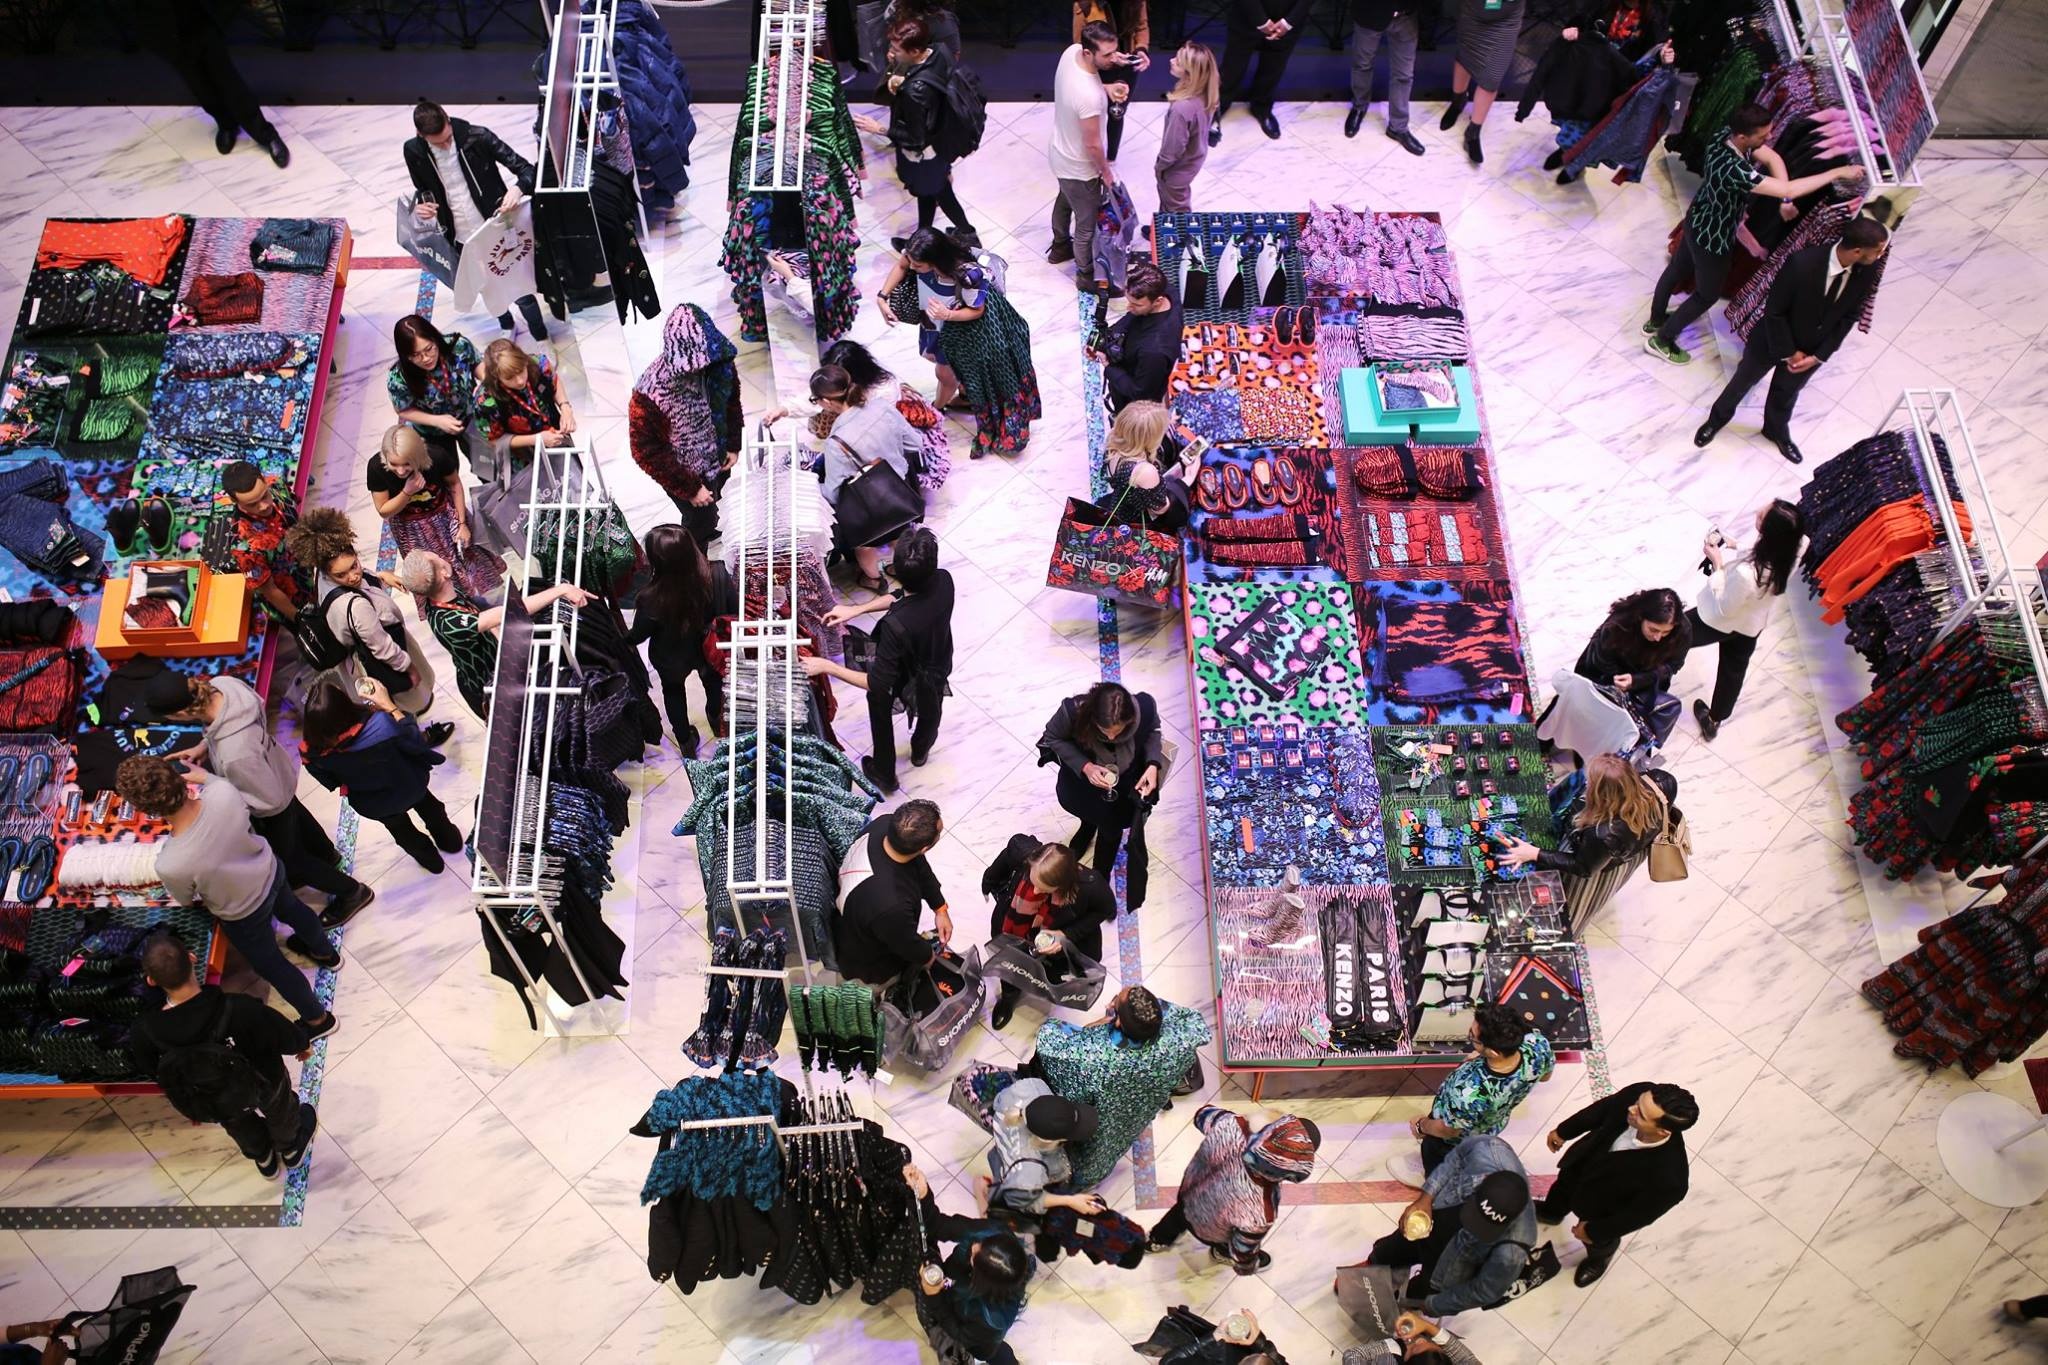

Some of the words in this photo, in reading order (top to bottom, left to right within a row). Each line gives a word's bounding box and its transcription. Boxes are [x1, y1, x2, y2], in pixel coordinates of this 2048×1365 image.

[1061, 550, 1121, 576] KENZO
[1000, 960, 1050, 991] SHOPPIN
[1335, 943, 1353, 1016] KENZO
[1366, 952, 1390, 1023] PARIS
[938, 998, 980, 1047] SHOPPING
[1480, 1199, 1507, 1223] MAN
[1362, 1276, 1389, 1334] SHOPPIN
[119, 1322, 150, 1365] OPPING
